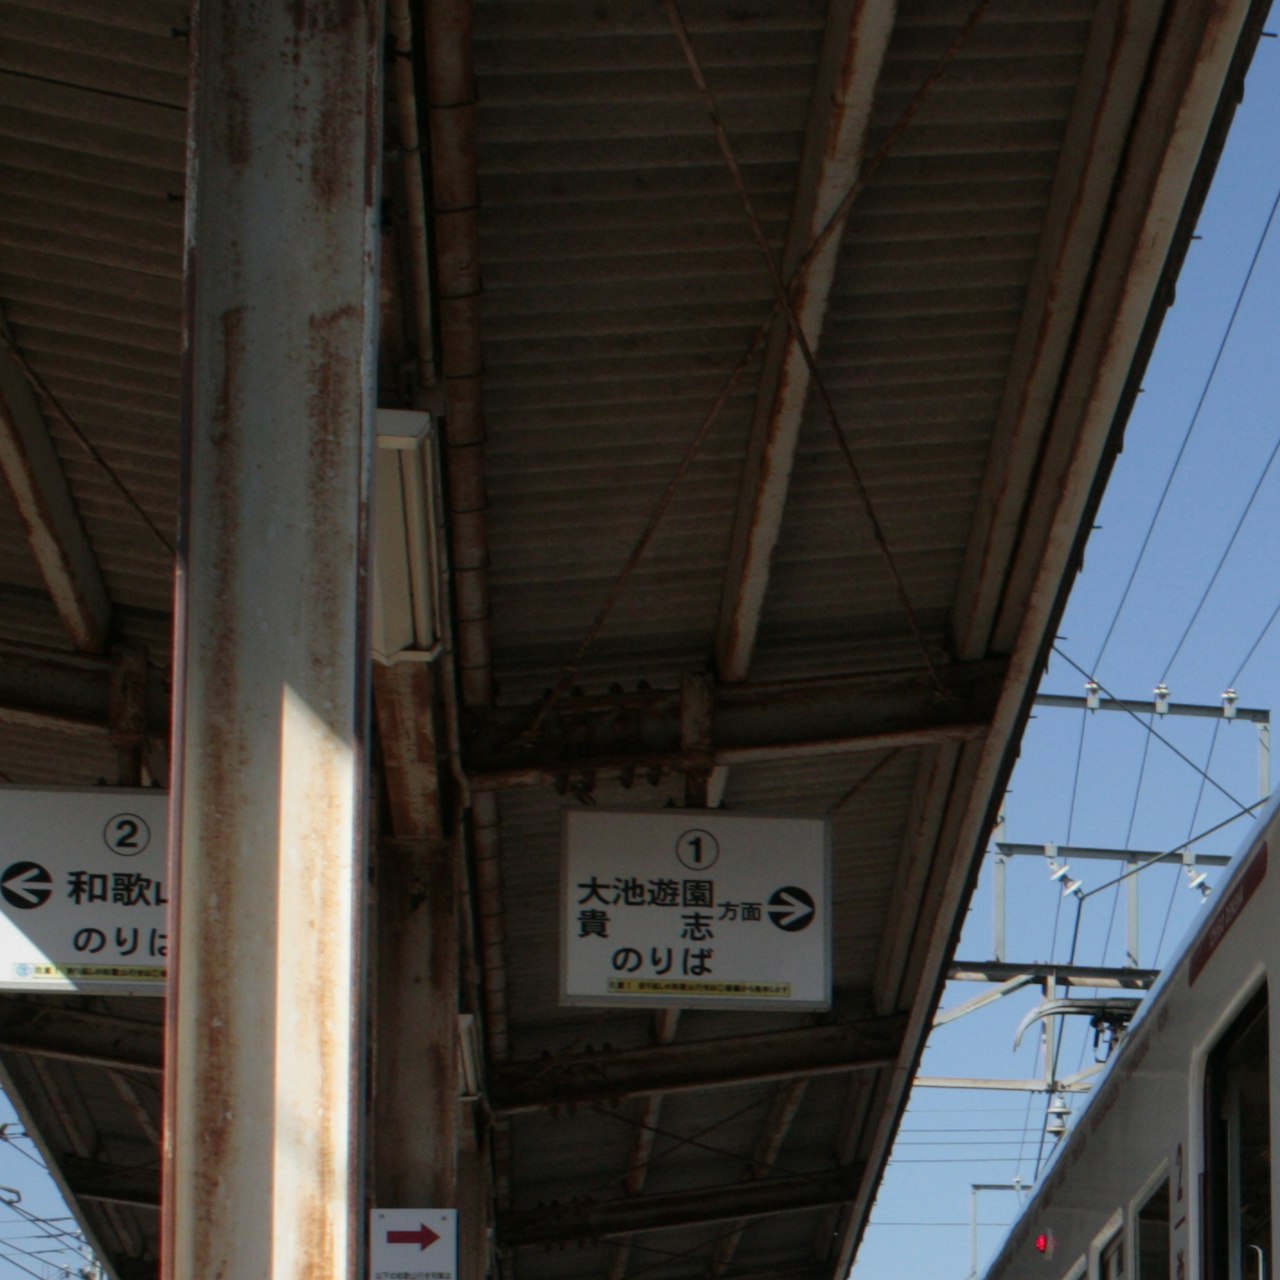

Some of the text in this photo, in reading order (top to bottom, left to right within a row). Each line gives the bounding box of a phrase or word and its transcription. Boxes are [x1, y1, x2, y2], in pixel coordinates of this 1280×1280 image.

[576, 876, 714, 909] 大池遊園
[717, 901, 763, 922] 方面
[611, 946, 714, 976] のりば
